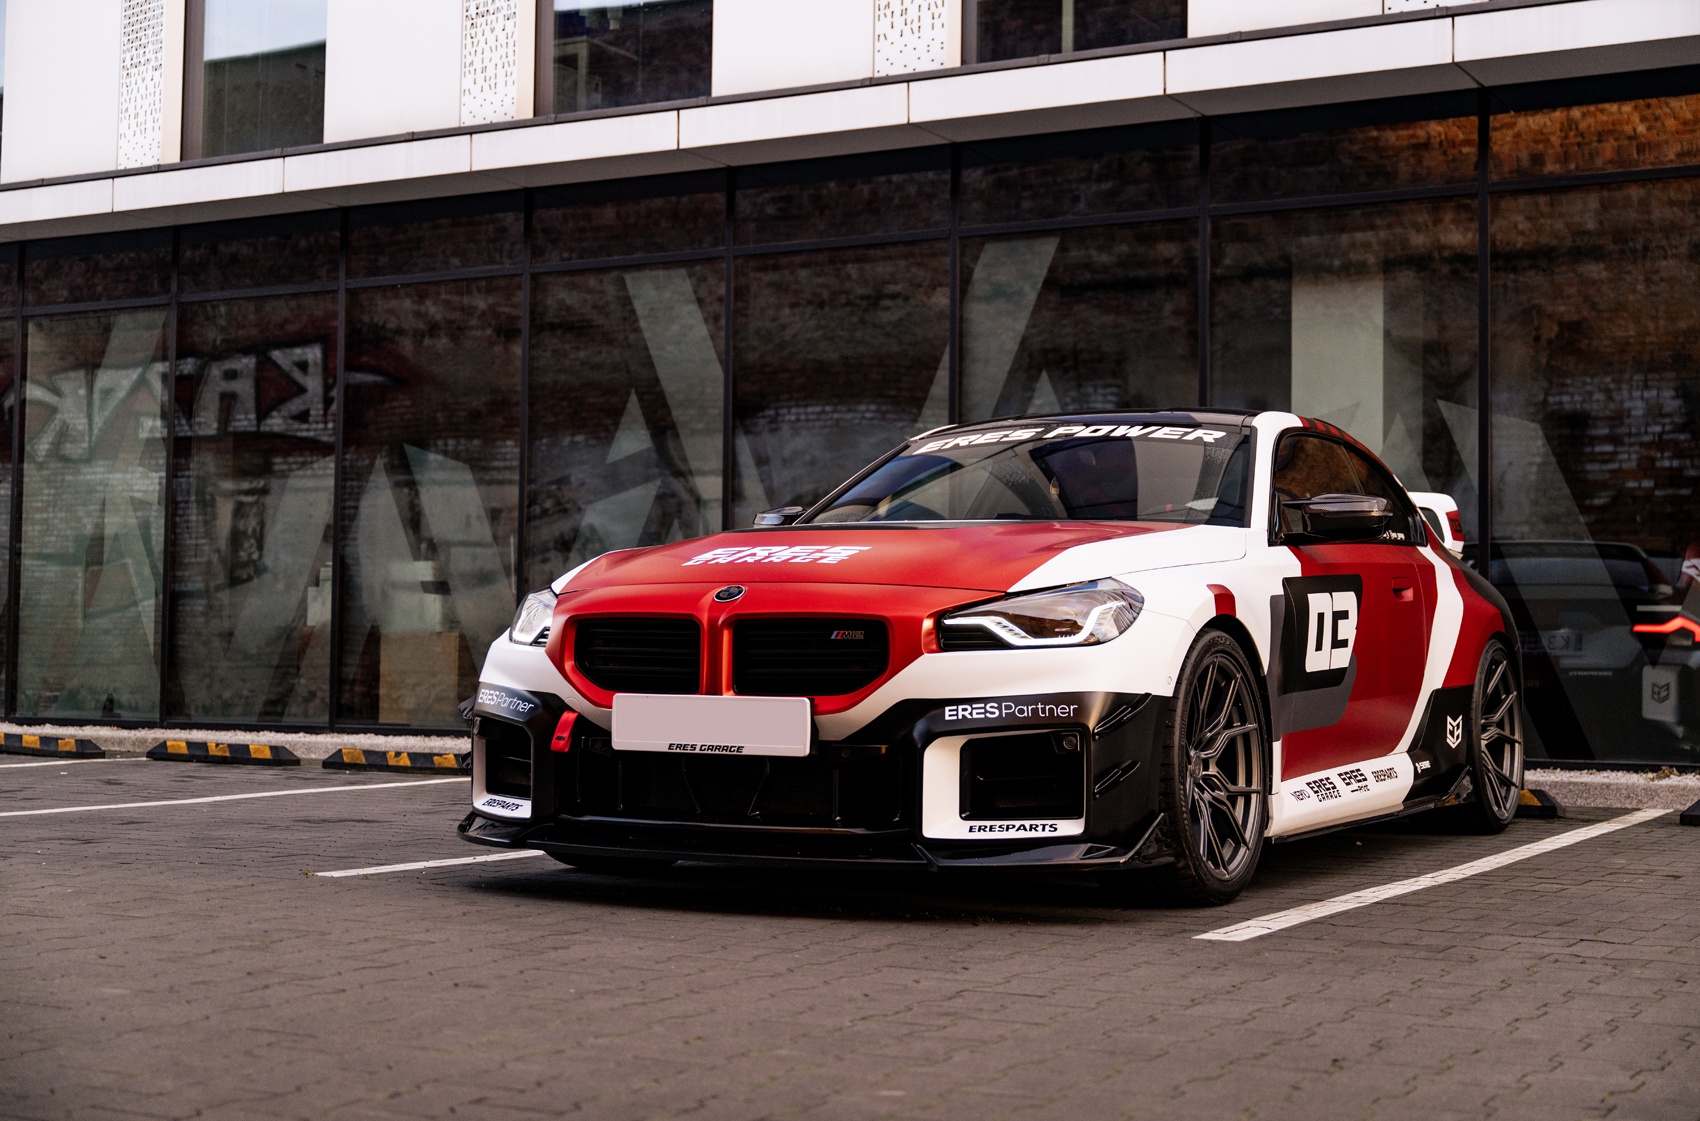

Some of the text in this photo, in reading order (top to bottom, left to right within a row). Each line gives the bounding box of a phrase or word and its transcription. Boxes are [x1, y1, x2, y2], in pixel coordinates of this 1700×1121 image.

[912, 425, 1227, 455] ERES POWER
[691, 545, 873, 560] ERES
[681, 556, 849, 566] GARAGE
[1305, 591, 1358, 673] 03
[667, 743, 745, 753] ERES GARAGE
[1337, 768, 1368, 786] ERES
[1305, 776, 1337, 795] ERES
[1316, 789, 1342, 803] GARAGE
[968, 823, 1058, 833] ERESPARTS
